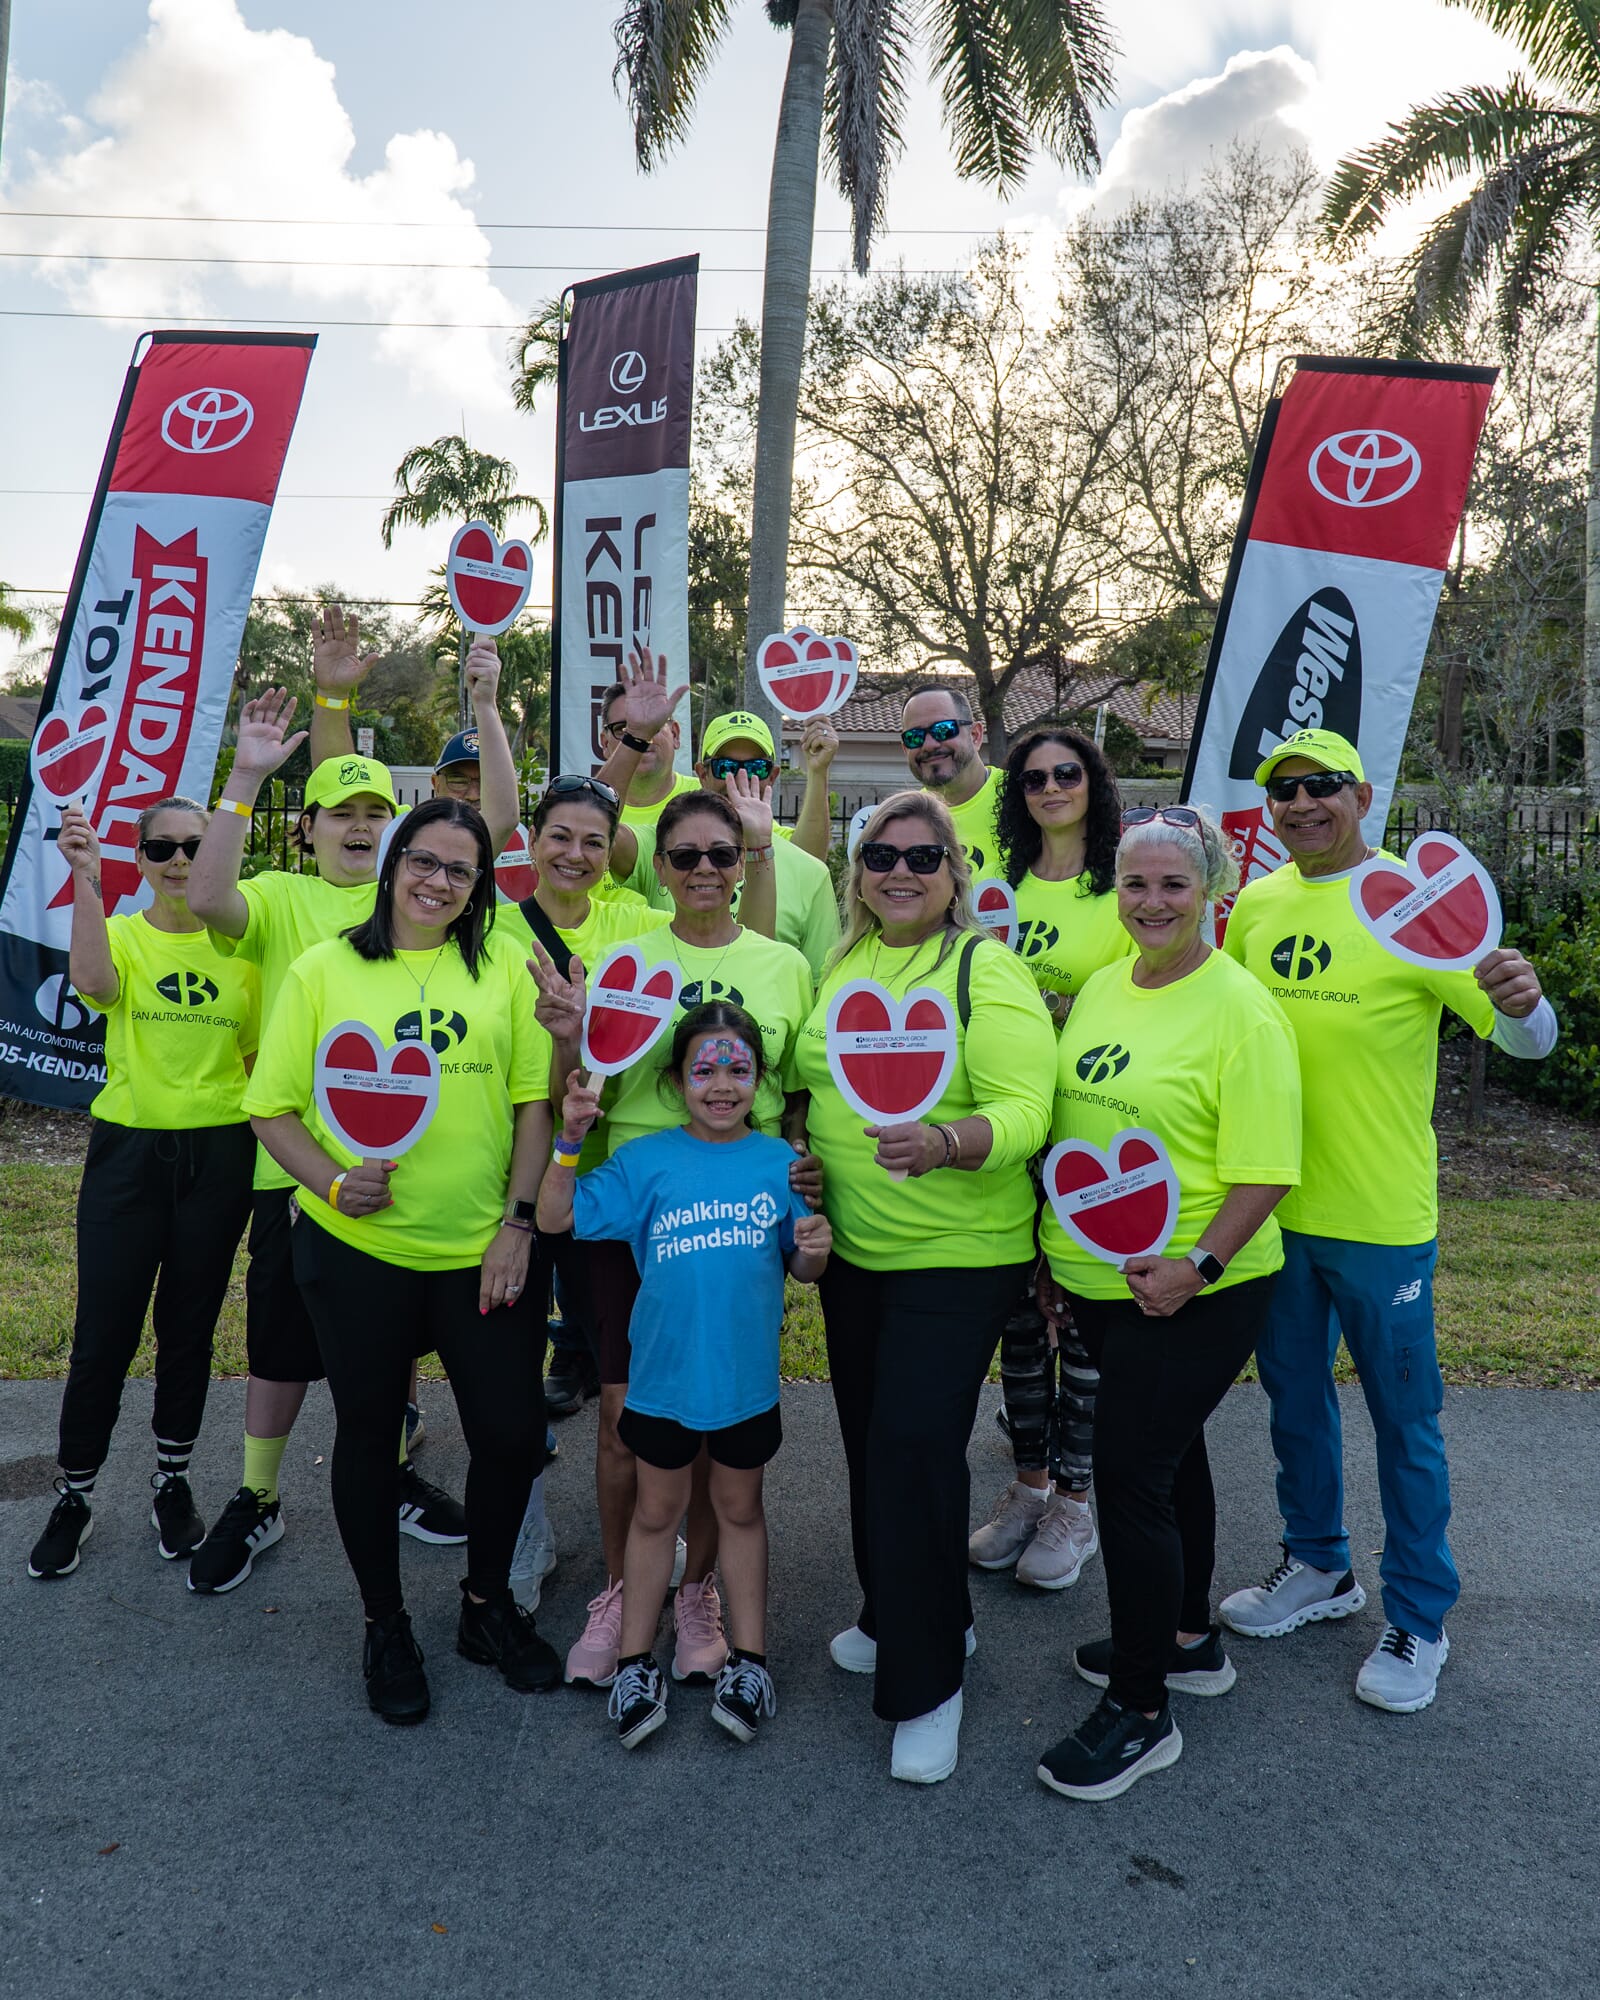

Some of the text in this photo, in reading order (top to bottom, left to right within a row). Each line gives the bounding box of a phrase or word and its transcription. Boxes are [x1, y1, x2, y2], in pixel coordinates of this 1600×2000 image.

[579, 395, 667, 432] LEXUS
[131, 1010, 150, 1020] EAN
[151, 1011, 212, 1025] AUTOMOTIVE
[0, 1019, 21, 1034] EAN
[21, 1027, 87, 1052] AUTOMOTIVE
[1062, 1089, 1107, 1107] AUTOMOTIVE
[660, 1199, 748, 1231] Walking
[656, 1226, 766, 1264] Friendship
